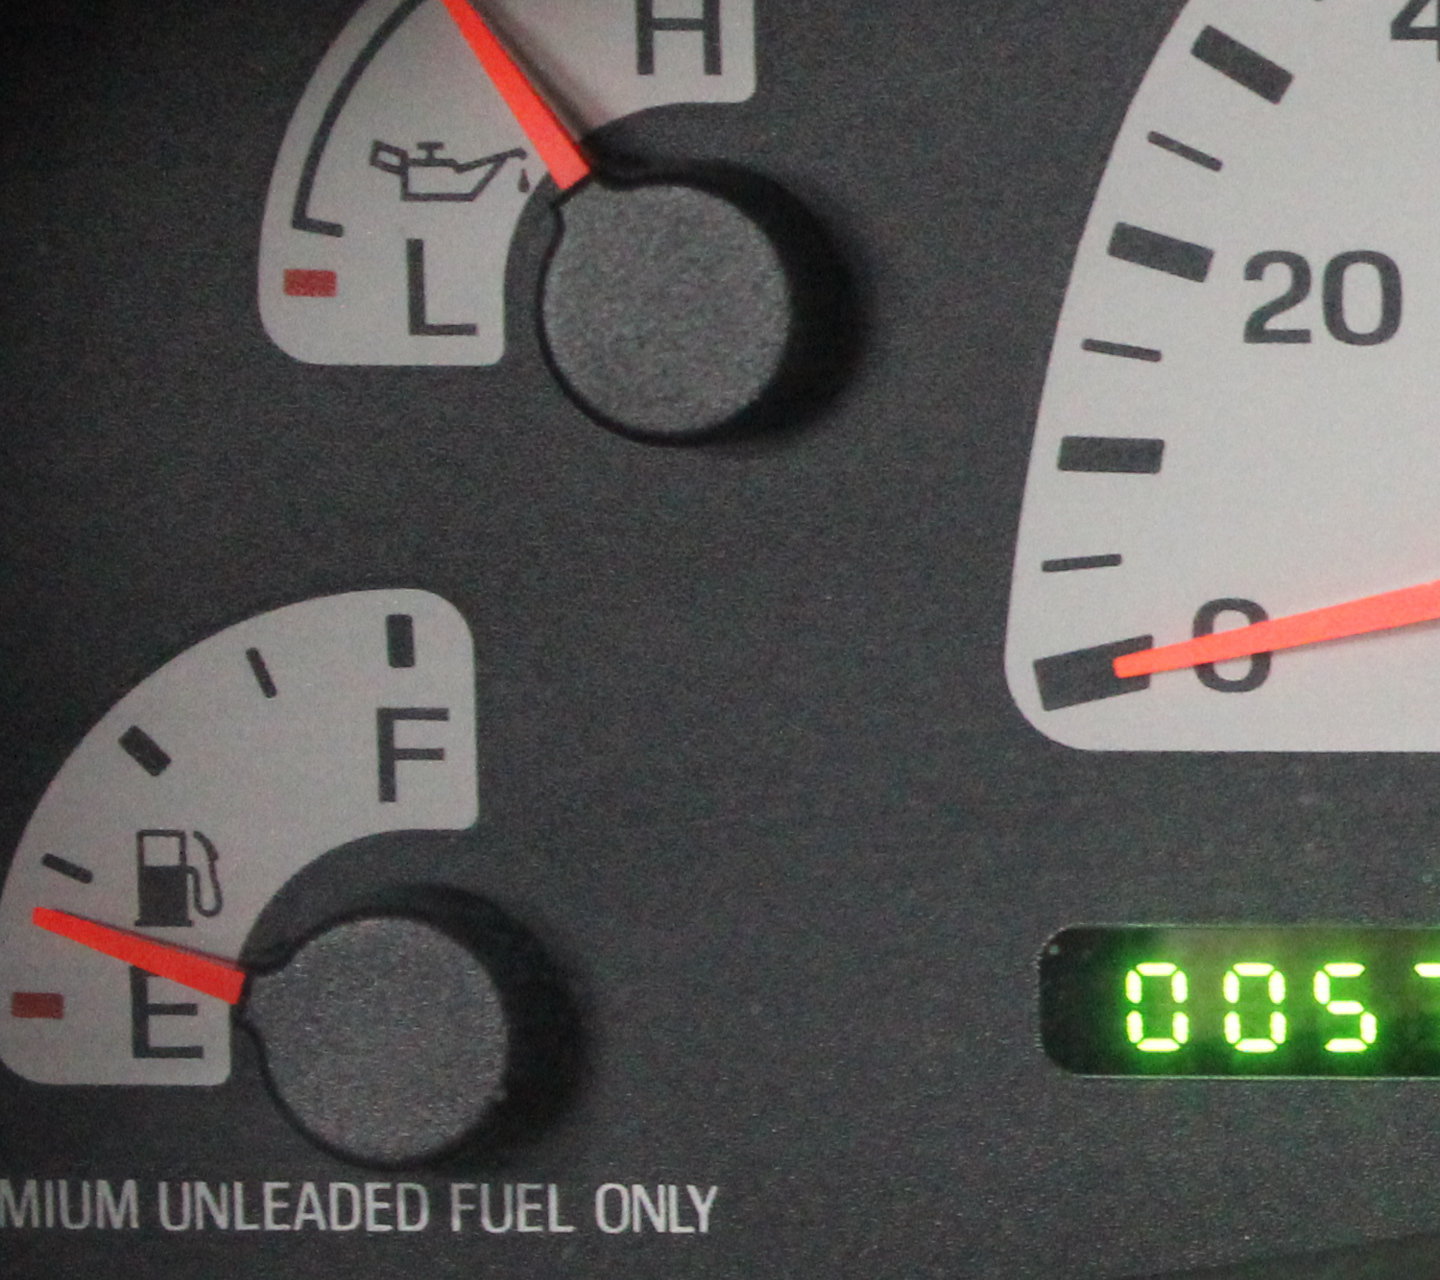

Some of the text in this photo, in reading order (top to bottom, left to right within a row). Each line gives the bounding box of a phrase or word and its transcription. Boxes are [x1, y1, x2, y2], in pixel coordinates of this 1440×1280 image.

[406, 238, 477, 336] L
[1244, 250, 1402, 346] 20
[1192, 598, 1272, 692] 0
[377, 707, 449, 803] F
[130, 966, 204, 1059] E
[160, 1182, 429, 1232] UNLEADED
[451, 1183, 576, 1233] FUEL
[596, 1183, 718, 1233] ONLY
